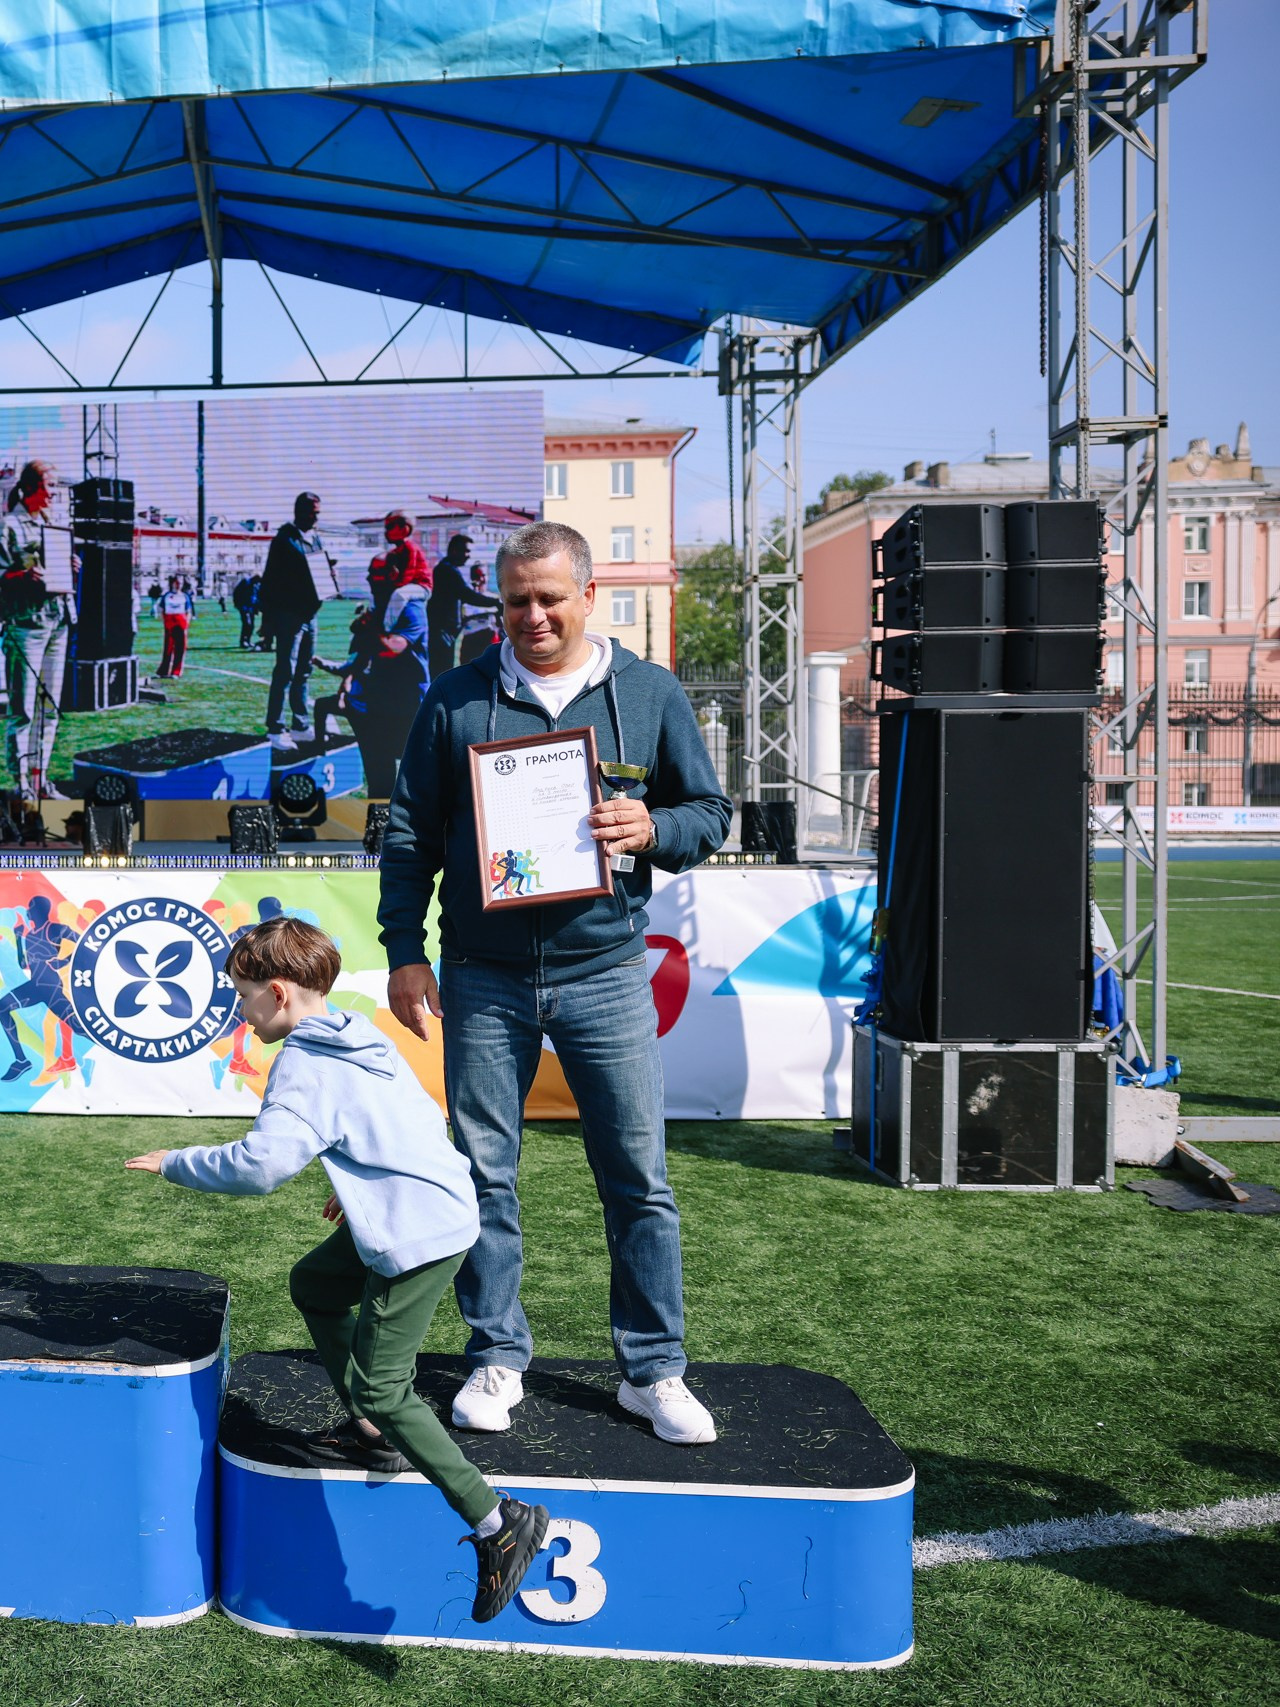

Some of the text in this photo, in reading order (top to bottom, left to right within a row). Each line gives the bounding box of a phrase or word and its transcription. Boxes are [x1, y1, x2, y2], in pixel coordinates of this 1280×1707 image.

[323, 763, 336, 792] 3
[525, 749, 584, 766] ГРАМОТА
[84, 901, 225, 954] КОМОС ГРУПП
[84, 1006, 227, 1058] СПАРТАКИАДА
[519, 1518, 607, 1622] 3
